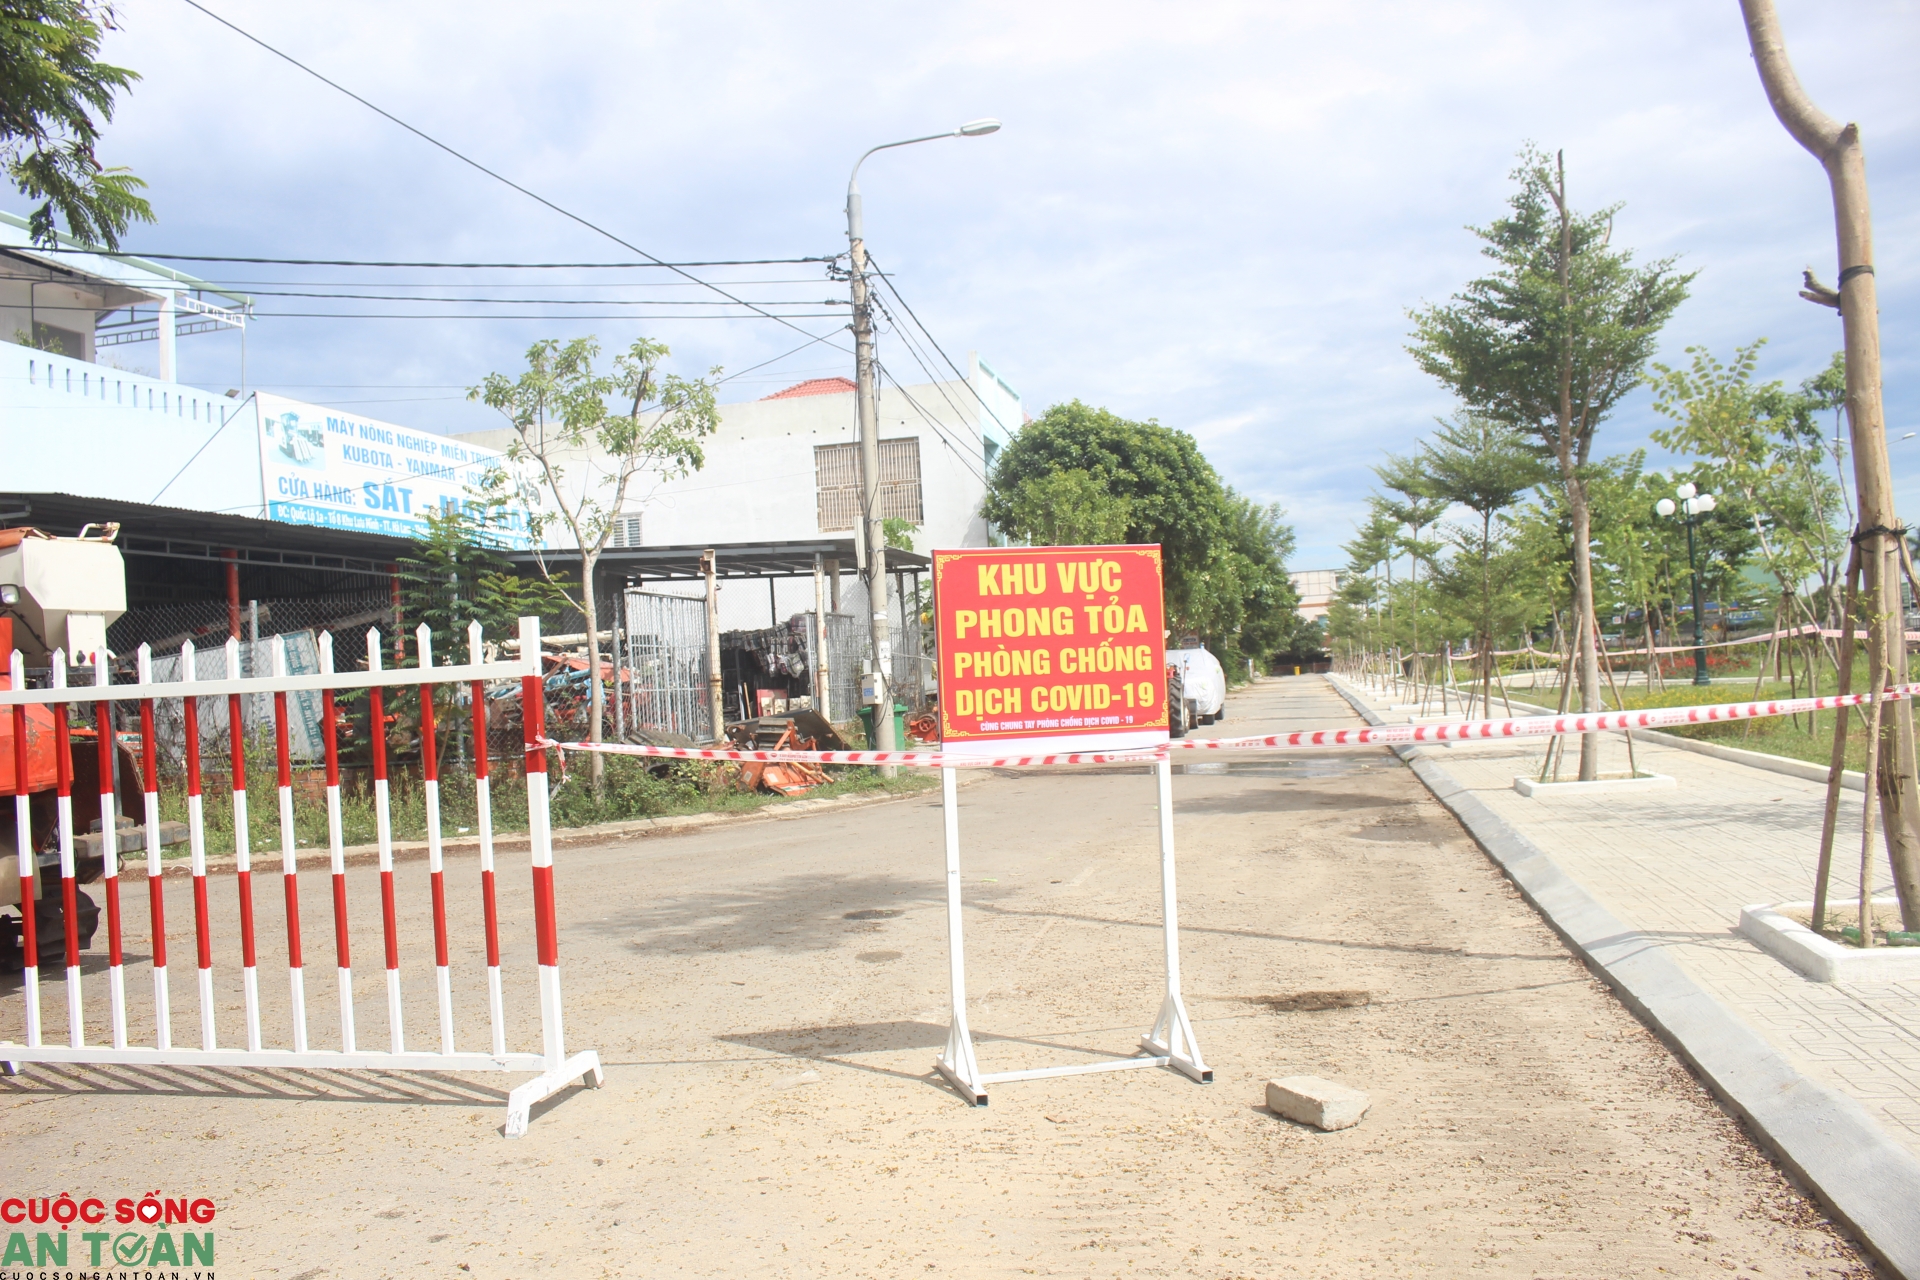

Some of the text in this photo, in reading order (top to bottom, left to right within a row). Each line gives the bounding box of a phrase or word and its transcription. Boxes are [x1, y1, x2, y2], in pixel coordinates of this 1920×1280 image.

[326, 416, 355, 437] MÁY
[359, 423, 393, 446] NÔNG
[396, 433, 437, 457] NGHIỆP
[343, 443, 394, 469] KUBOTA
[405, 457, 456, 481] YANMAR
[278, 472, 309, 499] CỬA
[314, 480, 356, 506] HÀNG:
[363, 477, 413, 514] SẮT
[978, 558, 1122, 600] KHU VỰC
[955, 595, 1149, 639] PHONG TỎA
[954, 637, 1152, 679] PHÒNG CHỐNG
[955, 682, 1155, 721] DỊCH COVID-19
[980, 721, 999, 732] CÙNG
[1000, 721, 1023, 731] CHUNG
[1024, 720, 1035, 729] TAY
[1036, 717, 1059, 728] PHÒNG
[1060, 715, 1083, 727] CHỐNG
[1084, 717, 1099, 728] DỊCH
[1100, 715, 1120, 725] COVID
[1125, 715, 1133, 724] 19
